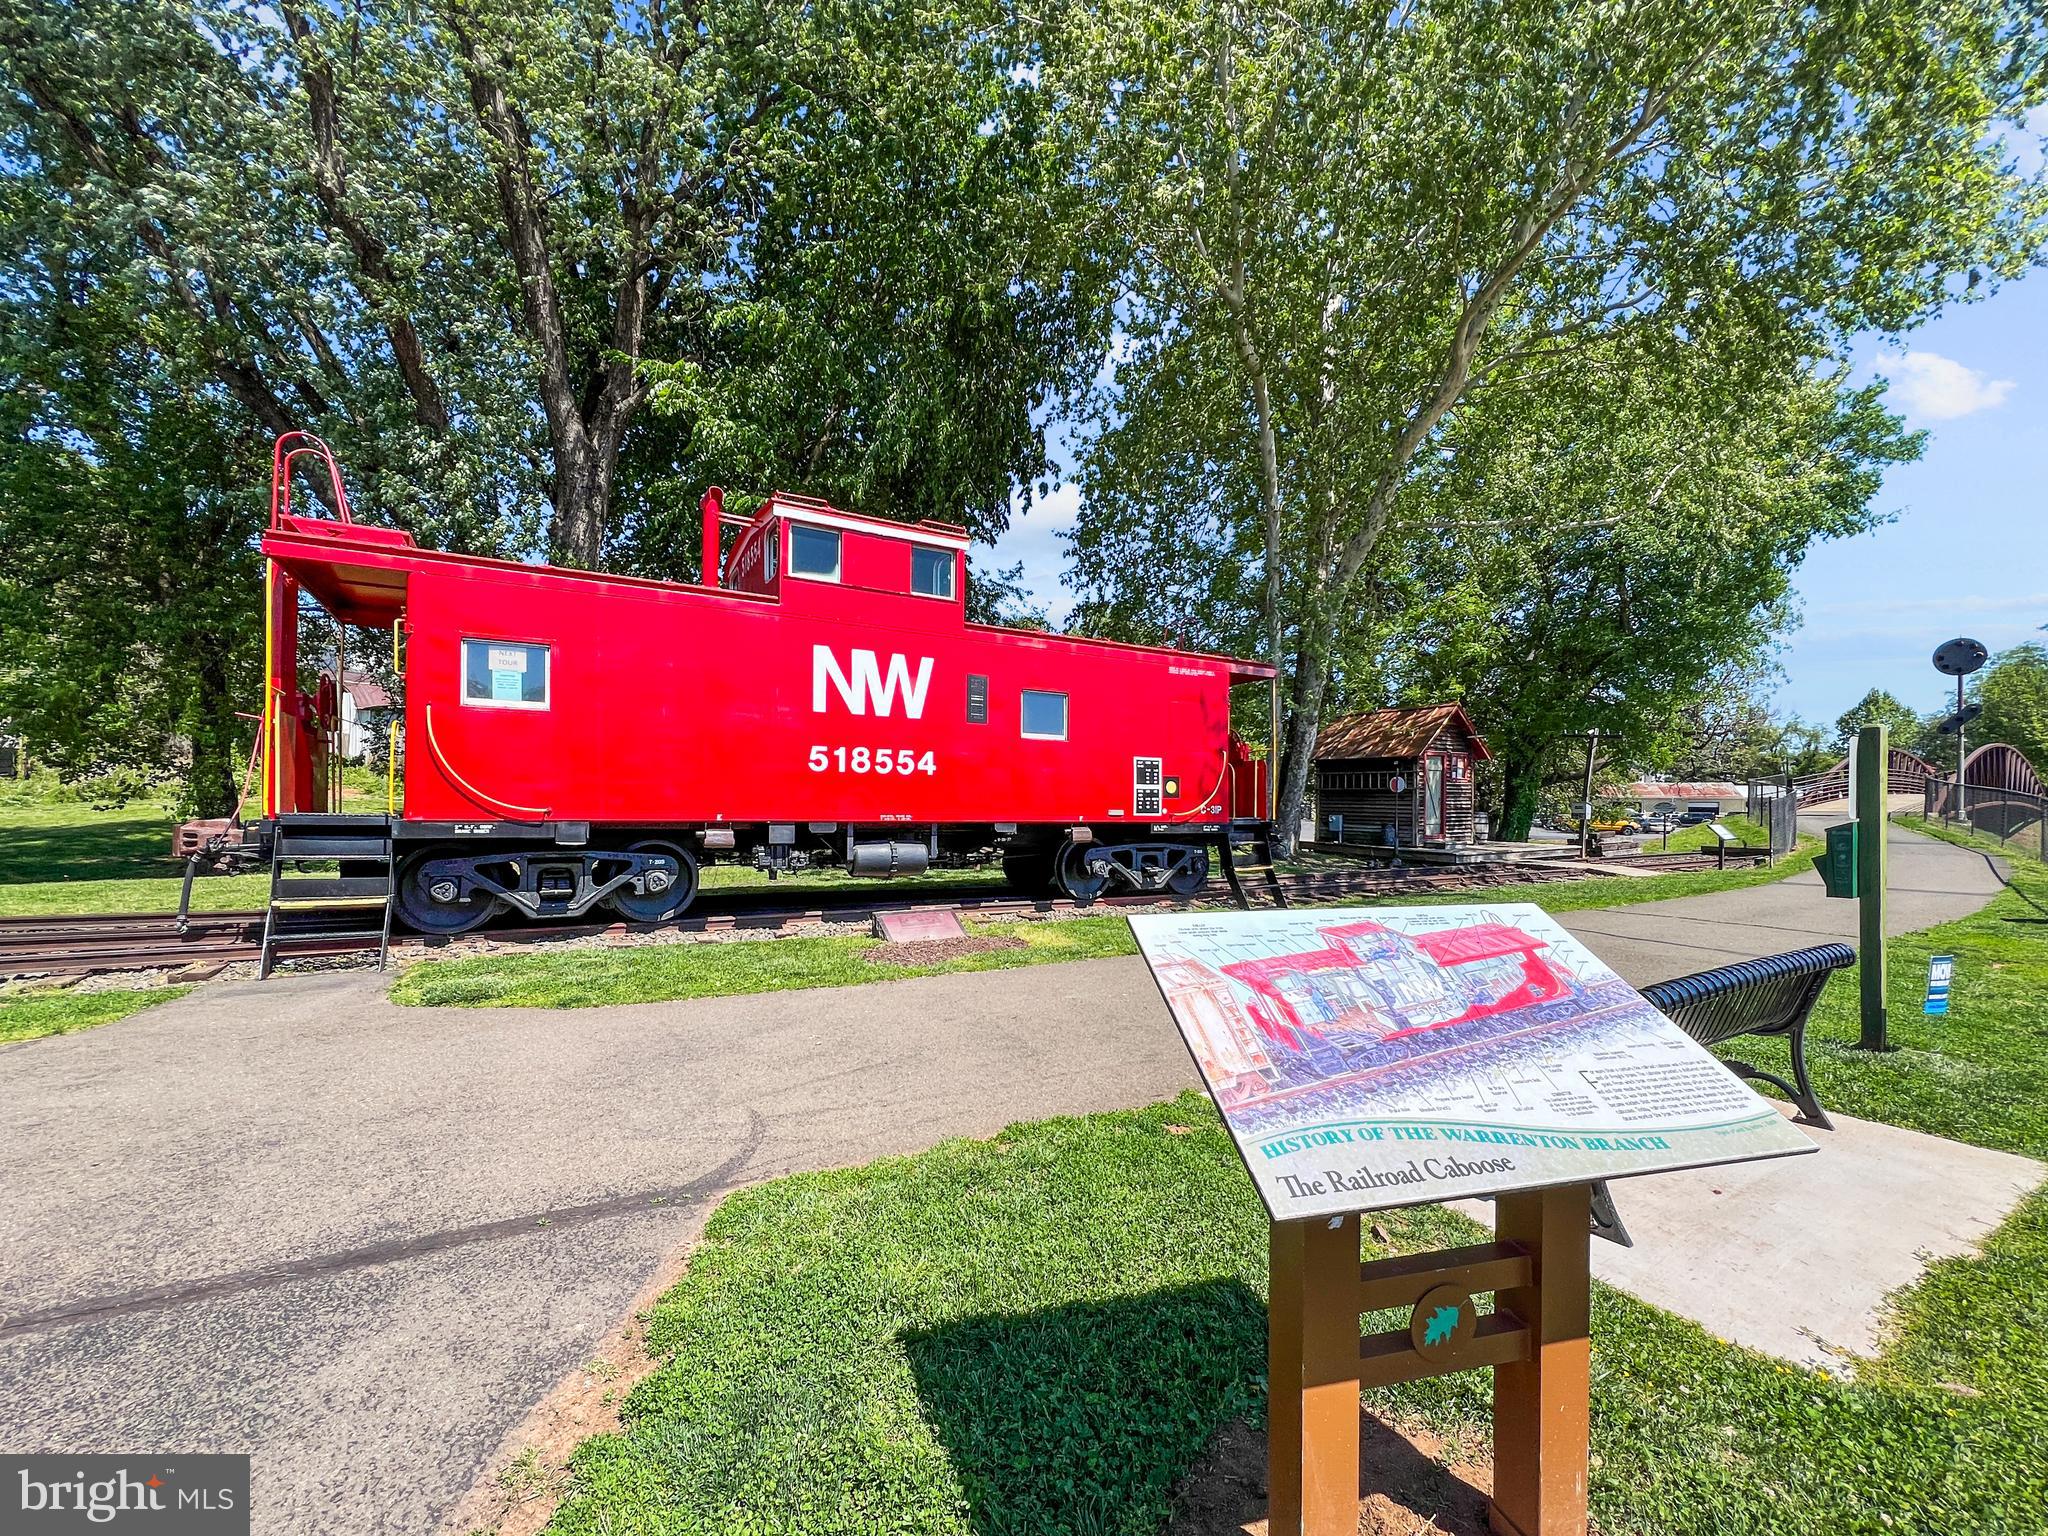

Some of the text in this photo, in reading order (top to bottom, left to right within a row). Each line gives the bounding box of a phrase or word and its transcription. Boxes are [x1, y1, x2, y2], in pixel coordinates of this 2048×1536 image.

[812, 643, 935, 720] NW
[807, 745, 937, 776] 518554
[1259, 1126, 1673, 1160] HISTORY OF THE WARRENTON BRANCH
[1275, 1156, 1516, 1198] The Railroad Caboose
